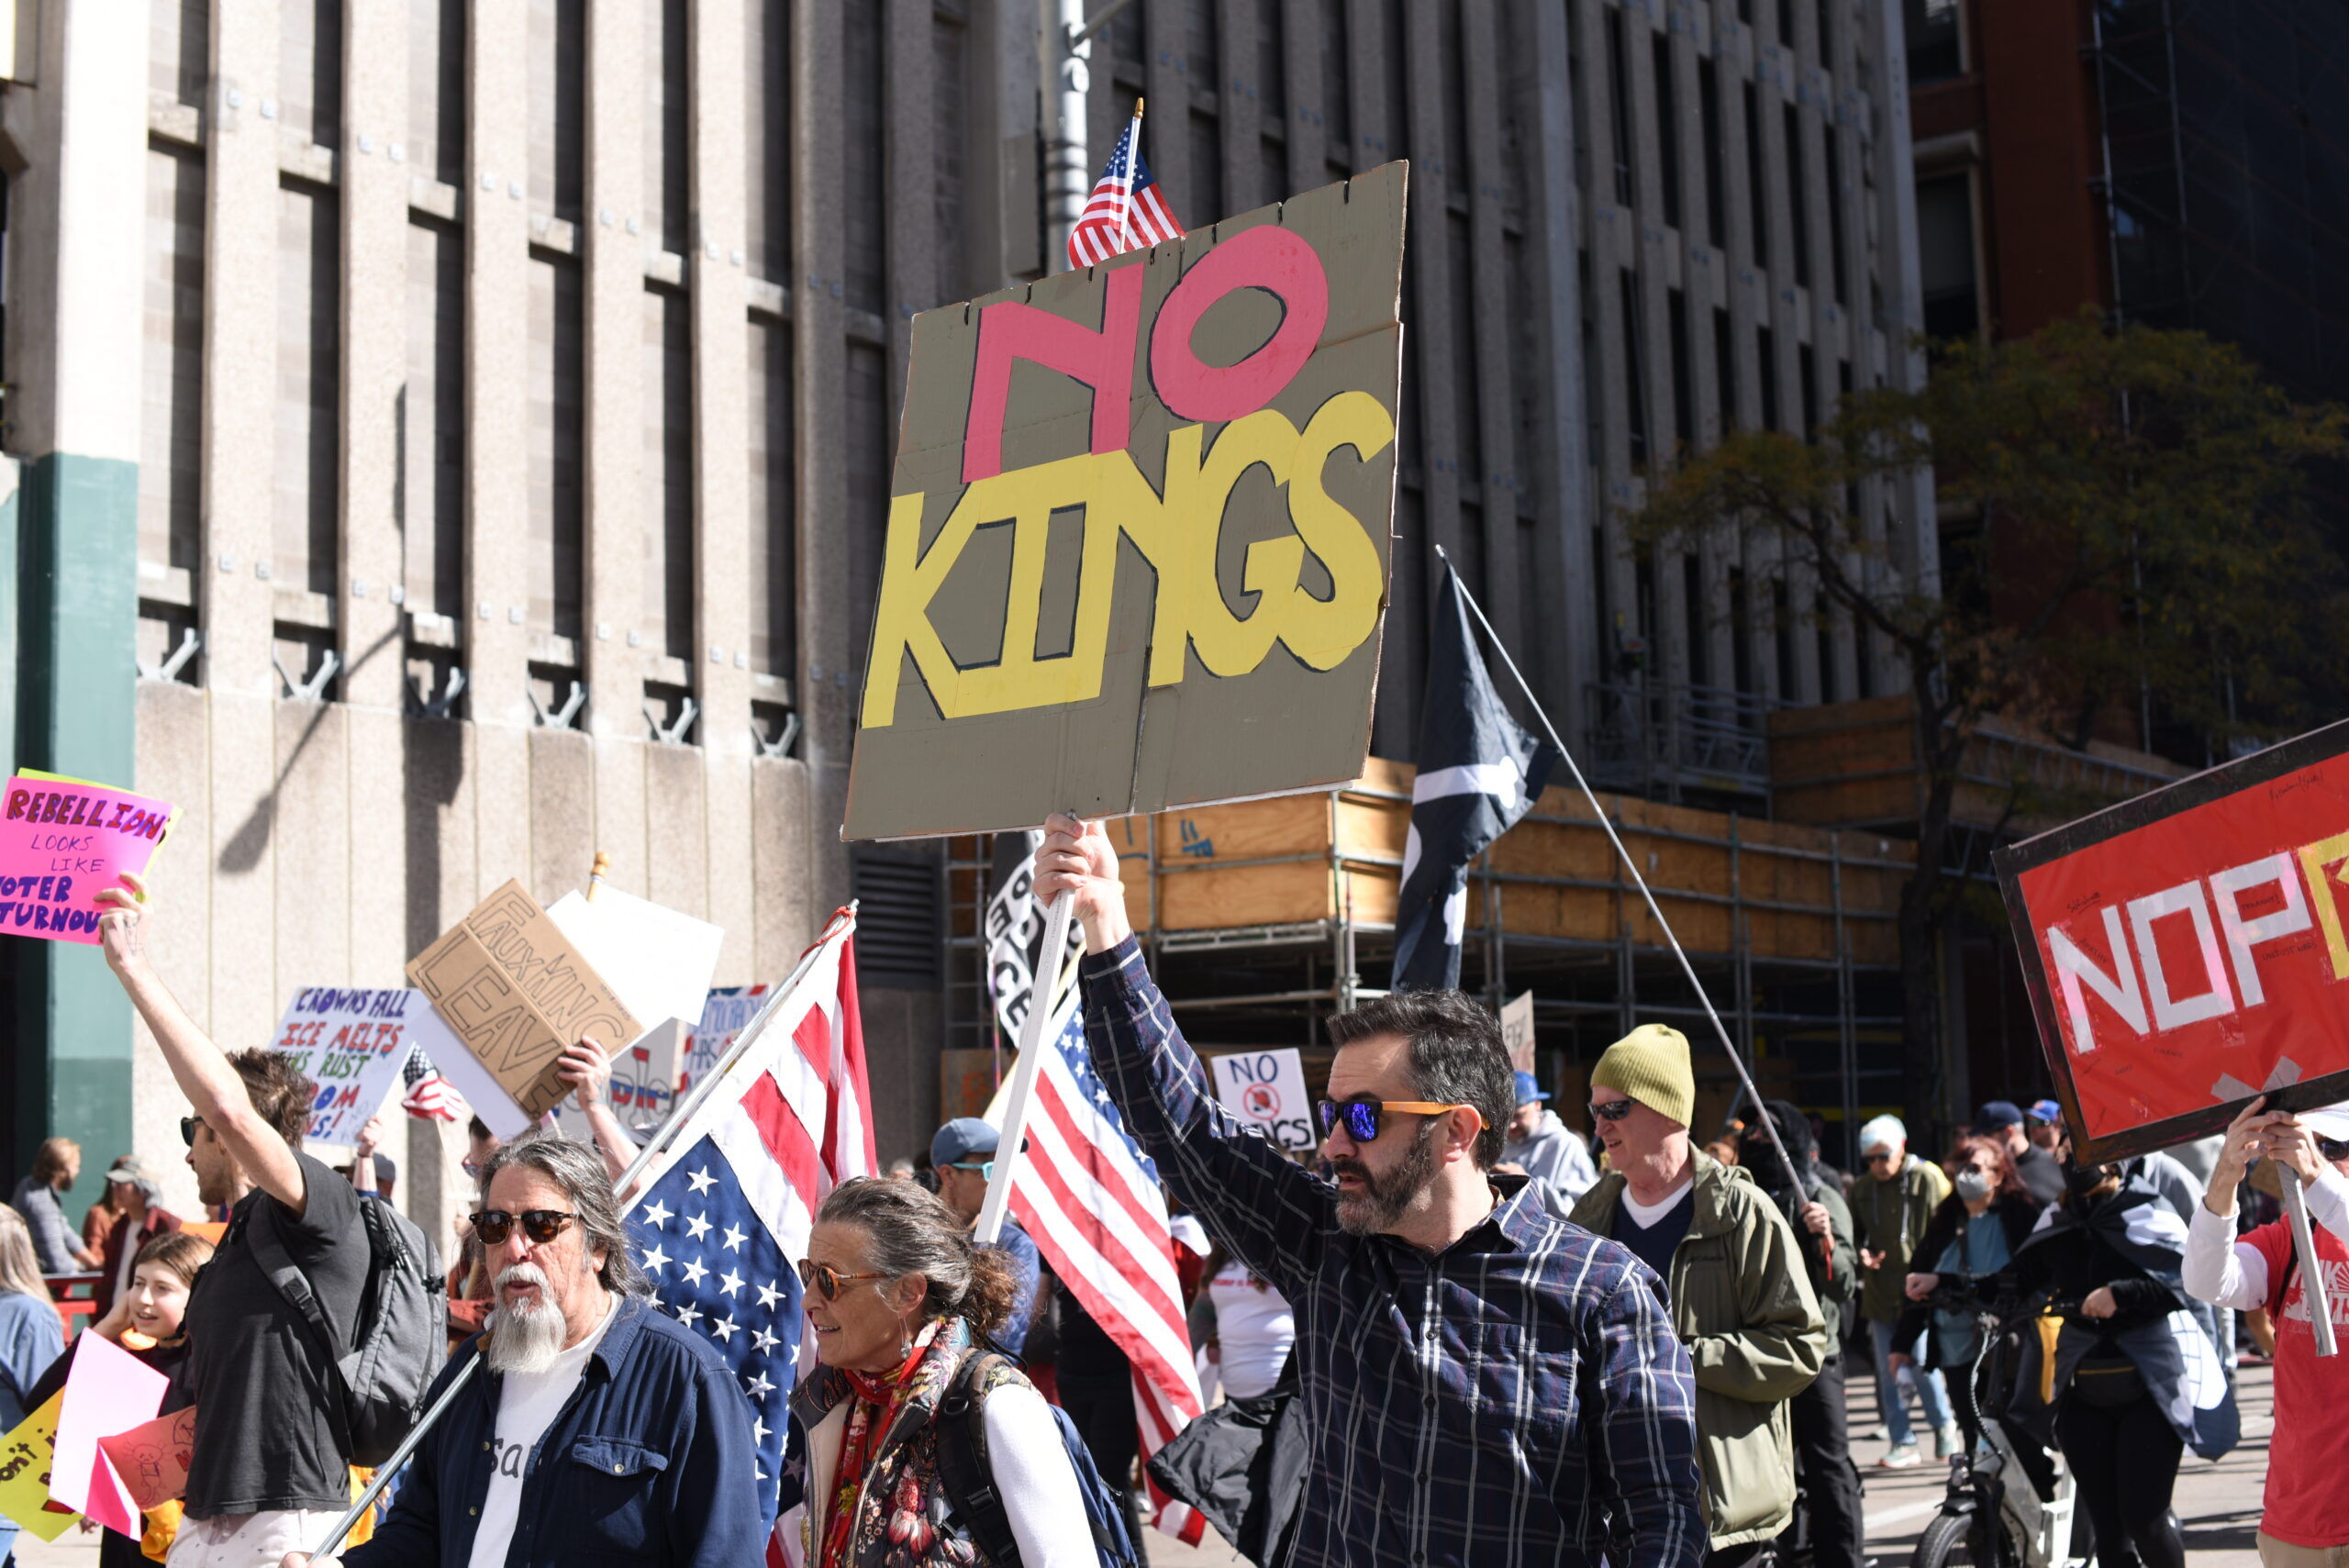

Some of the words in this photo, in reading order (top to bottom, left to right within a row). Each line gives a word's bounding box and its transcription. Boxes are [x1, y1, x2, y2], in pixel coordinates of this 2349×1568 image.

[962, 224, 1329, 484] NO
[861, 391, 1395, 728] KINGS
[6, 789, 165, 840] REBELLION
[30, 834, 94, 851] LOOKS
[51, 857, 105, 874] LIKE
[0, 902, 102, 934] TURNOU
[295, 987, 372, 1015] CROWNS
[368, 990, 411, 1018] FALL
[279, 1021, 327, 1046] ICE
[327, 1022, 405, 1057] MELTS
[317, 1052, 371, 1079] RUST
[1229, 1054, 1277, 1083] NO
